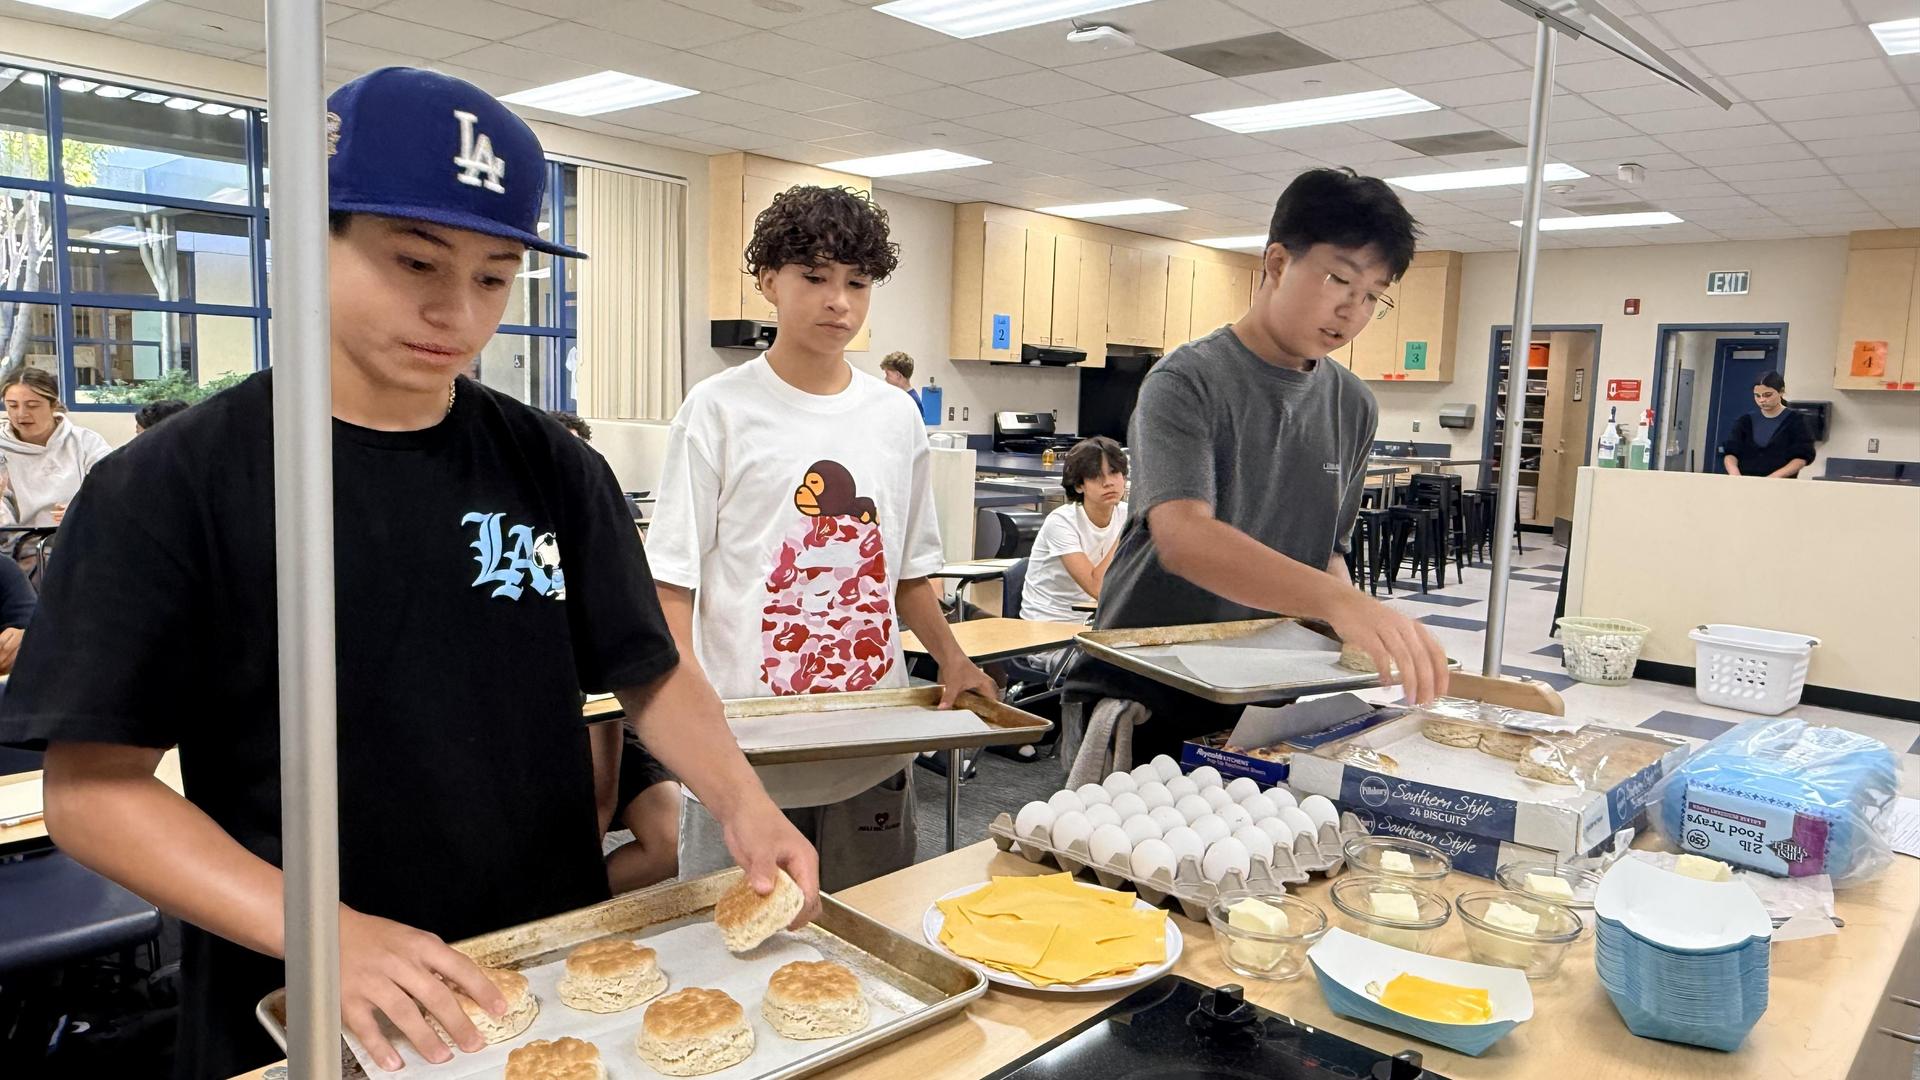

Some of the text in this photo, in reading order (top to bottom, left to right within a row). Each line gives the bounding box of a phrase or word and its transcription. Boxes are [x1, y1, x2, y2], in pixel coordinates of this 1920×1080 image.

[453, 109, 506, 195] LA
[1713, 272, 1746, 293] EXIT
[998, 328, 1005, 341] 2
[1411, 352, 1420, 363] 3
[1863, 356, 1874, 368] 4
[1196, 748, 1223, 761] Reynolds
[1362, 785, 1388, 797] Pillsbury
[1391, 783, 1496, 820] Southern Style
[1409, 806, 1467, 827] 24 BISCUITS
[1378, 815, 1437, 844] Southern
[1439, 832, 1478, 857] Style
[1686, 813, 1765, 843] Food Trays
[1689, 836, 1707, 846] 250
[1772, 841, 1809, 858] STREET
[1776, 848, 1804, 864] FIRST
